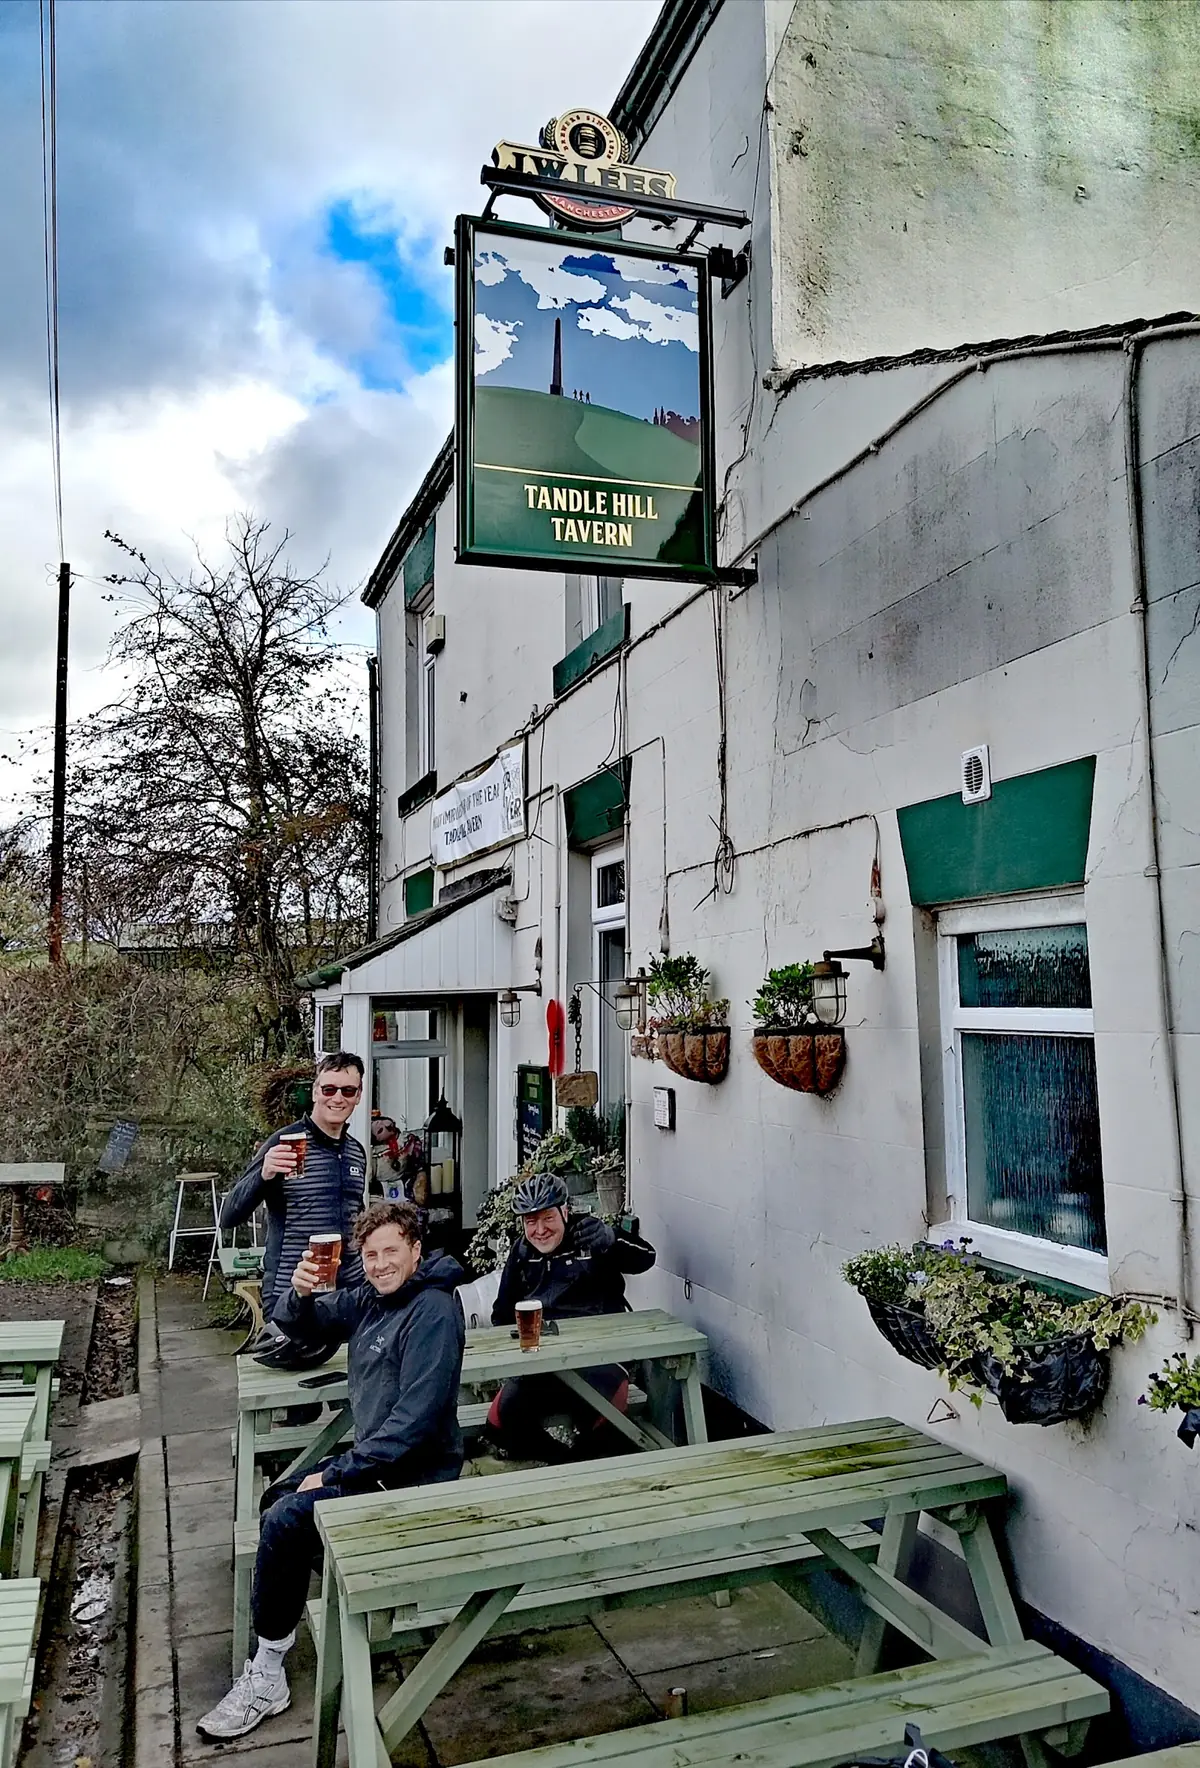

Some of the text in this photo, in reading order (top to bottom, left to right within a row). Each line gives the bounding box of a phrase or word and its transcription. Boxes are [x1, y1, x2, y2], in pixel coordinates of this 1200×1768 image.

[560, 115, 580, 151] BREWERS
[586, 115, 611, 136] SINCE
[551, 195, 625, 217] MANCHESTER
[524, 484, 659, 520] TANDLE HILL
[551, 517, 633, 547] TAVERN
